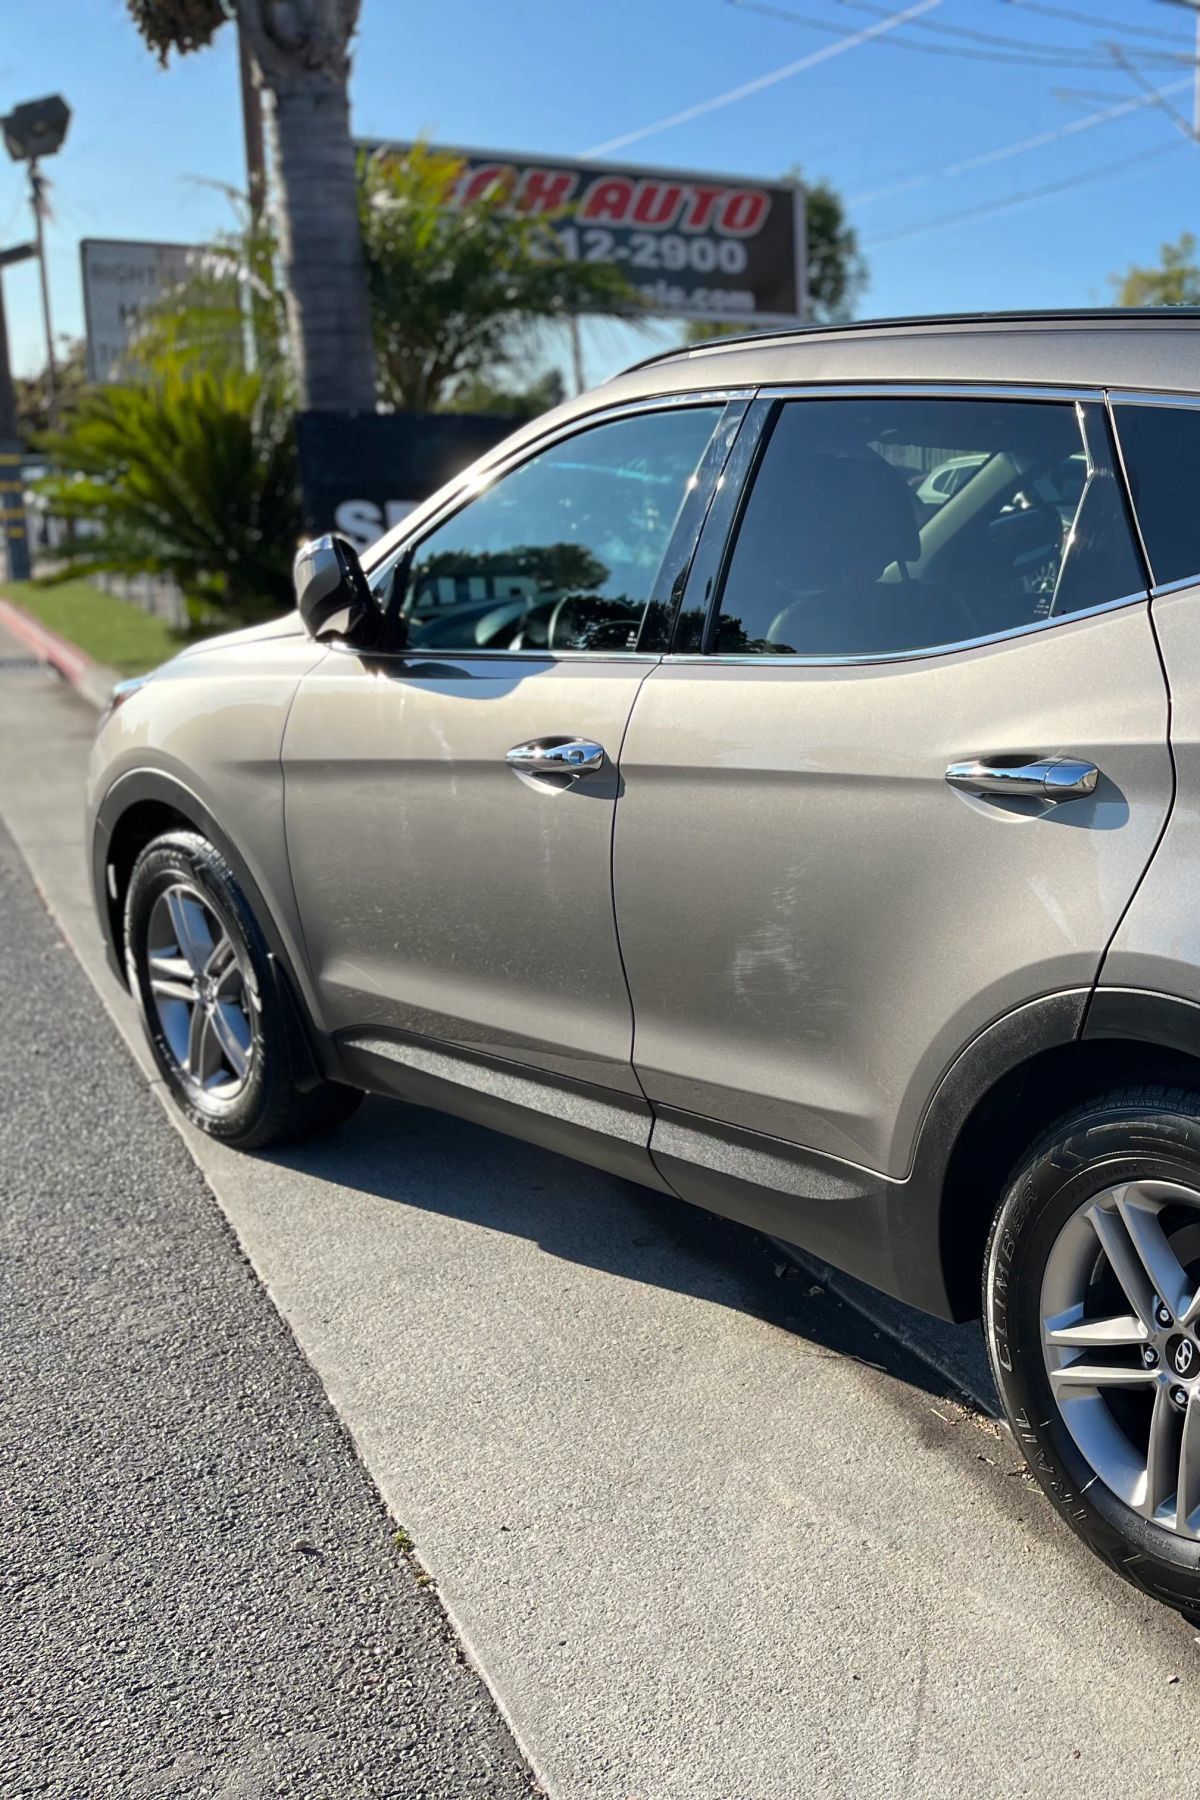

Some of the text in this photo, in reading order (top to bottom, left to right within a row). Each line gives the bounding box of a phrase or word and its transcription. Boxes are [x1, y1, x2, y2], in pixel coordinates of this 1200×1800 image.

[577, 175, 769, 237] AUTO
[994, 1174, 1087, 1527] TRAIL CLIMBER
